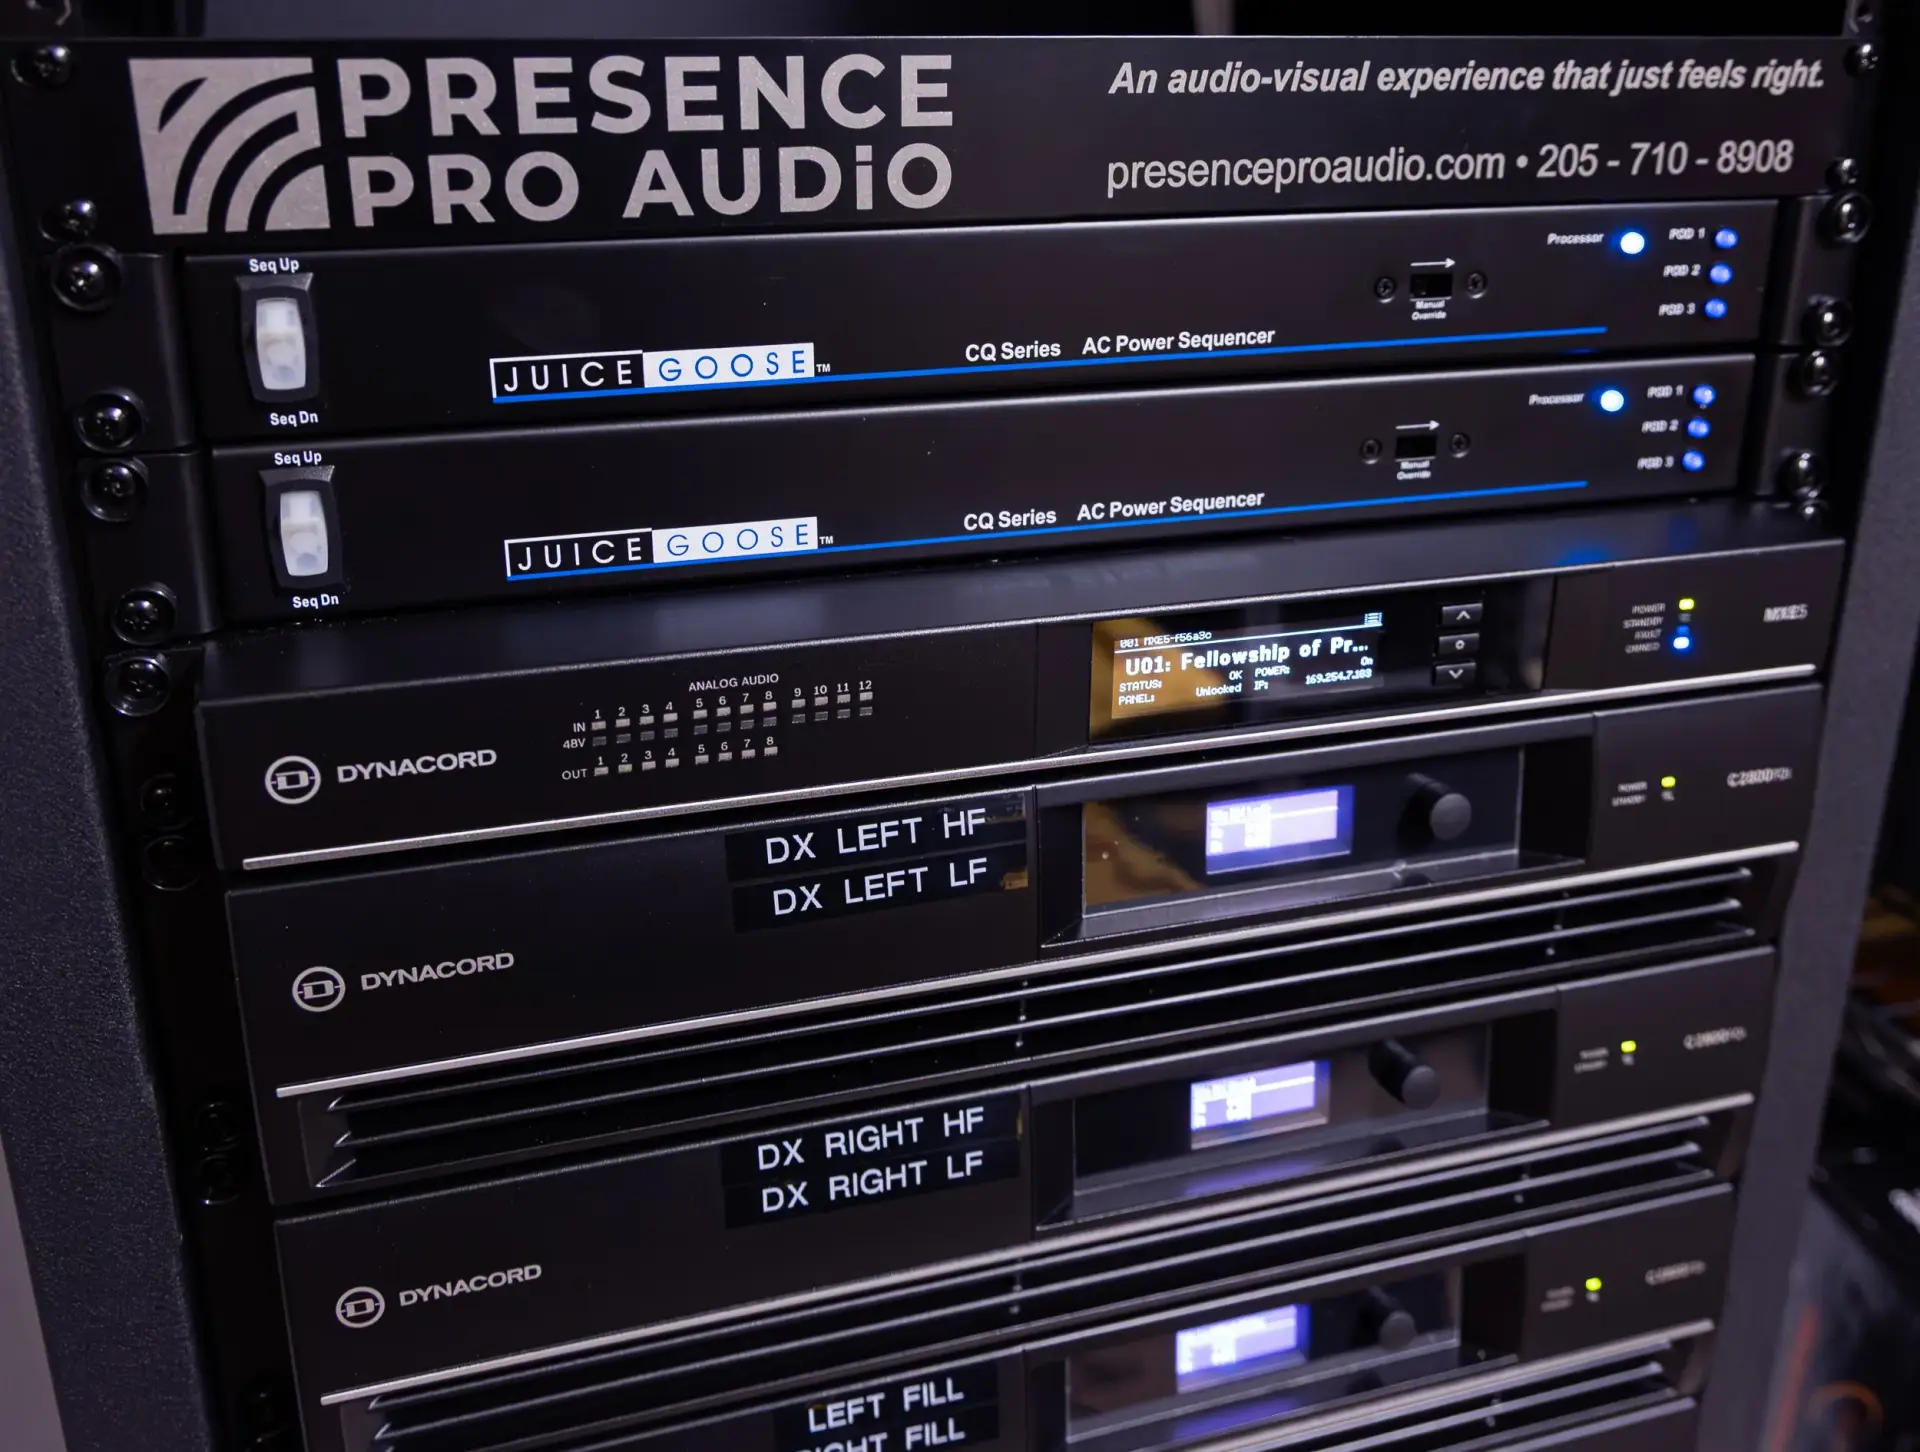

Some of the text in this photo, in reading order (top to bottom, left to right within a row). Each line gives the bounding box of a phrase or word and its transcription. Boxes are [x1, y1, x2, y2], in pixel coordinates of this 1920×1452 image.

[1107, 58, 1824, 99] An audio-visual experience that just feels right.
[337, 53, 954, 138] PRESENCE
[347, 142, 953, 227] PRO AUDiO
[1107, 146, 1506, 199] presenceproaudio.com
[1536, 142, 1599, 178] 205
[1630, 140, 1689, 176] 710
[1716, 139, 1794, 174] 8908
[248, 257, 300, 275] Seq Up
[965, 340, 1062, 362] CQ Series
[1081, 327, 1275, 355] AC Power Sequencer
[502, 359, 634, 392] JUICE
[657, 349, 808, 384] GOOSE
[269, 410, 319, 428] Seq Dn
[274, 450, 322, 467] Seq Up
[963, 508, 1057, 531] CQ Series
[1076, 492, 1266, 521] AC Power Sequencer
[516, 535, 644, 573] JUICE
[665, 523, 811, 558] GOOSE
[292, 593, 340, 610] Seq Dn
[1125, 655, 1172, 677] U01:
[1180, 645, 1291, 672] Fellowship
[1298, 638, 1323, 658] of
[1254, 655, 1374, 678] POWER: On
[688, 673, 779, 692] ANALOG AUDIO
[1118, 669, 1244, 693] STATUS: OK
[1118, 682, 1242, 706] PANEL: Unlocked
[1253, 679, 1269, 691] IP:
[594, 679, 872, 720] 1 2 3 4 5 6 7 8 9 10 11 12
[562, 737, 586, 749] 48V
[573, 721, 586, 733] IN
[336, 749, 497, 783] DYNACORD
[598, 736, 774, 766] 1 2 3 4 5 6 7 8
[561, 768, 588, 781] OUT
[765, 807, 986, 865] DX LEFT HF
[773, 857, 988, 916] DX LEFT LF
[360, 952, 515, 991] DYNACORD
[757, 1106, 984, 1171] DX RIGHT HF
[761, 1150, 984, 1213] DX RIGHT LF
[398, 1264, 542, 1307] DYNACORD
[808, 1377, 964, 1433] LEFT FILL
[905, 1417, 965, 1451] FILL
